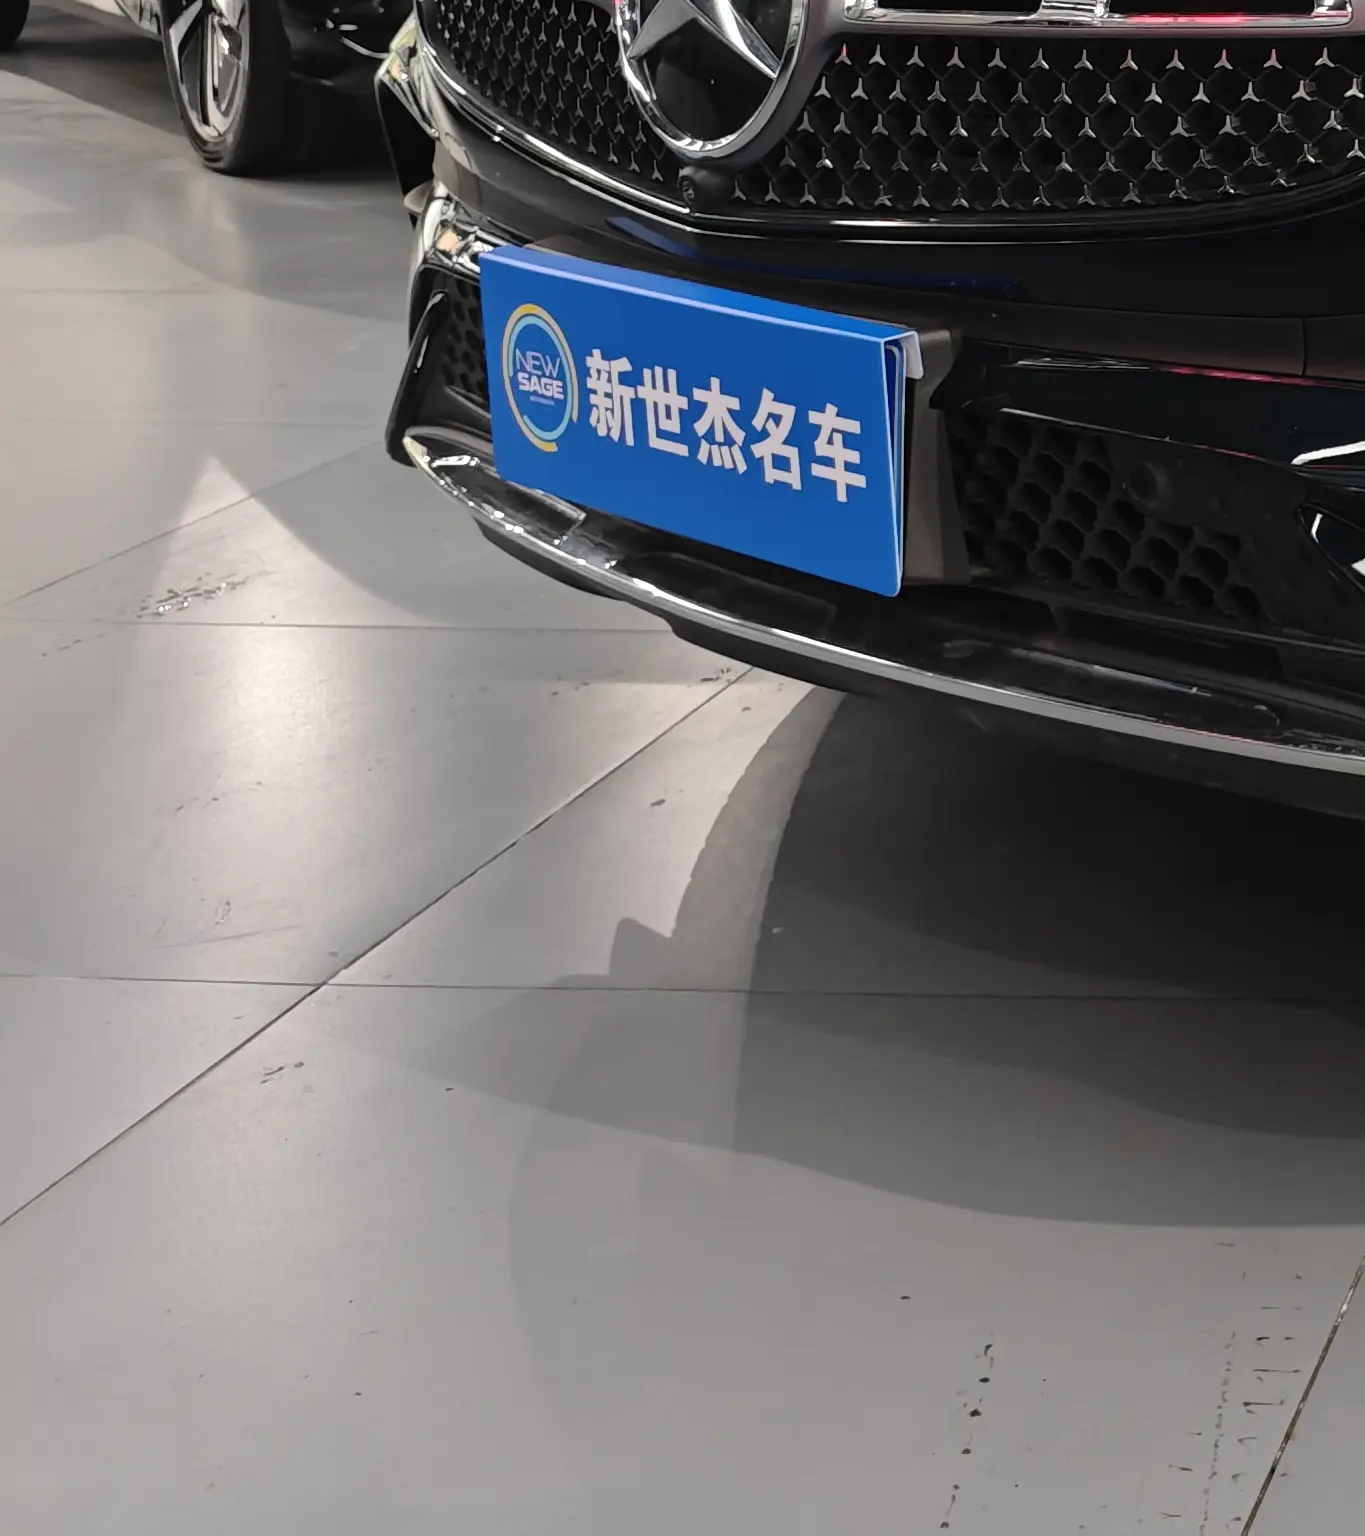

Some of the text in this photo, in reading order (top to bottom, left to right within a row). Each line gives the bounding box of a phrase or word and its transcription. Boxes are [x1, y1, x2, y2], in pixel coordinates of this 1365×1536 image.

[515, 348, 560, 378] NEW
[517, 371, 565, 400] SAGE
[585, 349, 867, 503] 新世杰名车
